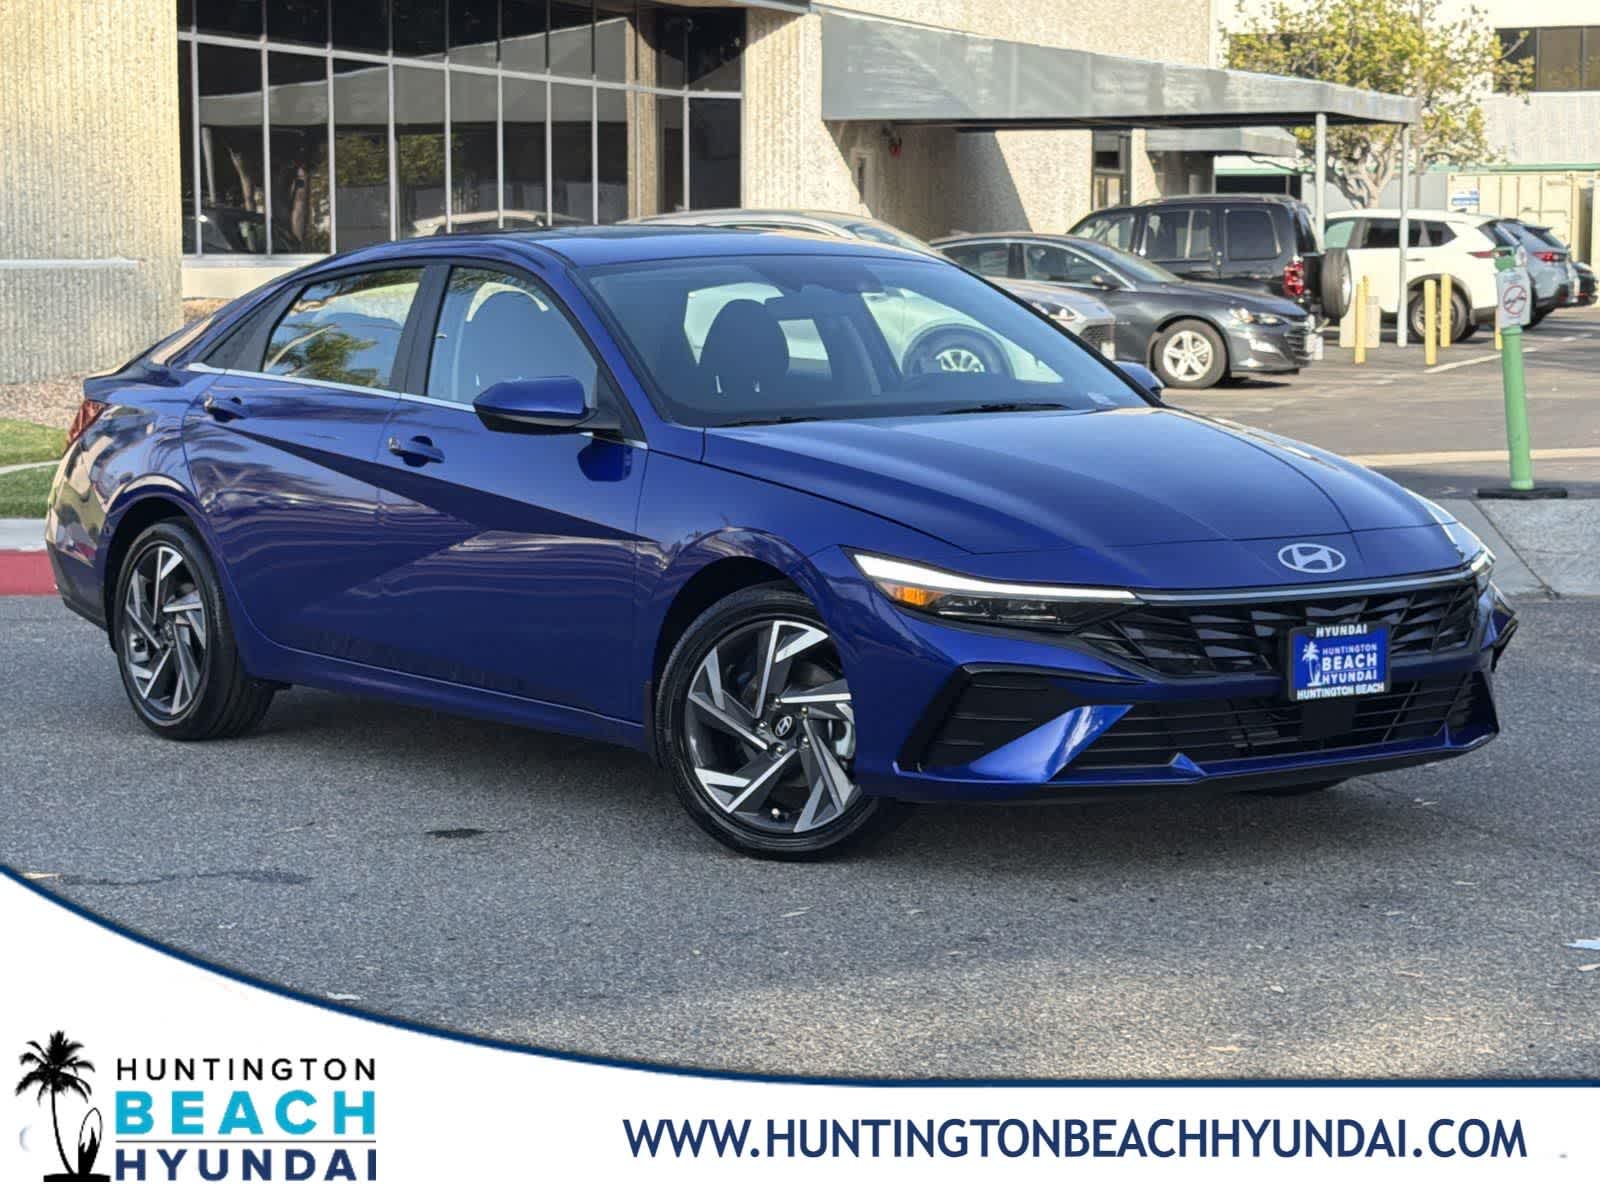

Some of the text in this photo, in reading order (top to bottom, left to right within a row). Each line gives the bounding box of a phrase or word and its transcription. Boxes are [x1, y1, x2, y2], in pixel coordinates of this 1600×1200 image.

[1316, 624, 1367, 637] HYUNDAI
[1322, 644, 1377, 656] HUNTINGTON
[1322, 653, 1377, 671] BEACH
[1322, 670, 1377, 685] HYUNDAI
[1297, 682, 1385, 700] HUNTINGTON BEACH
